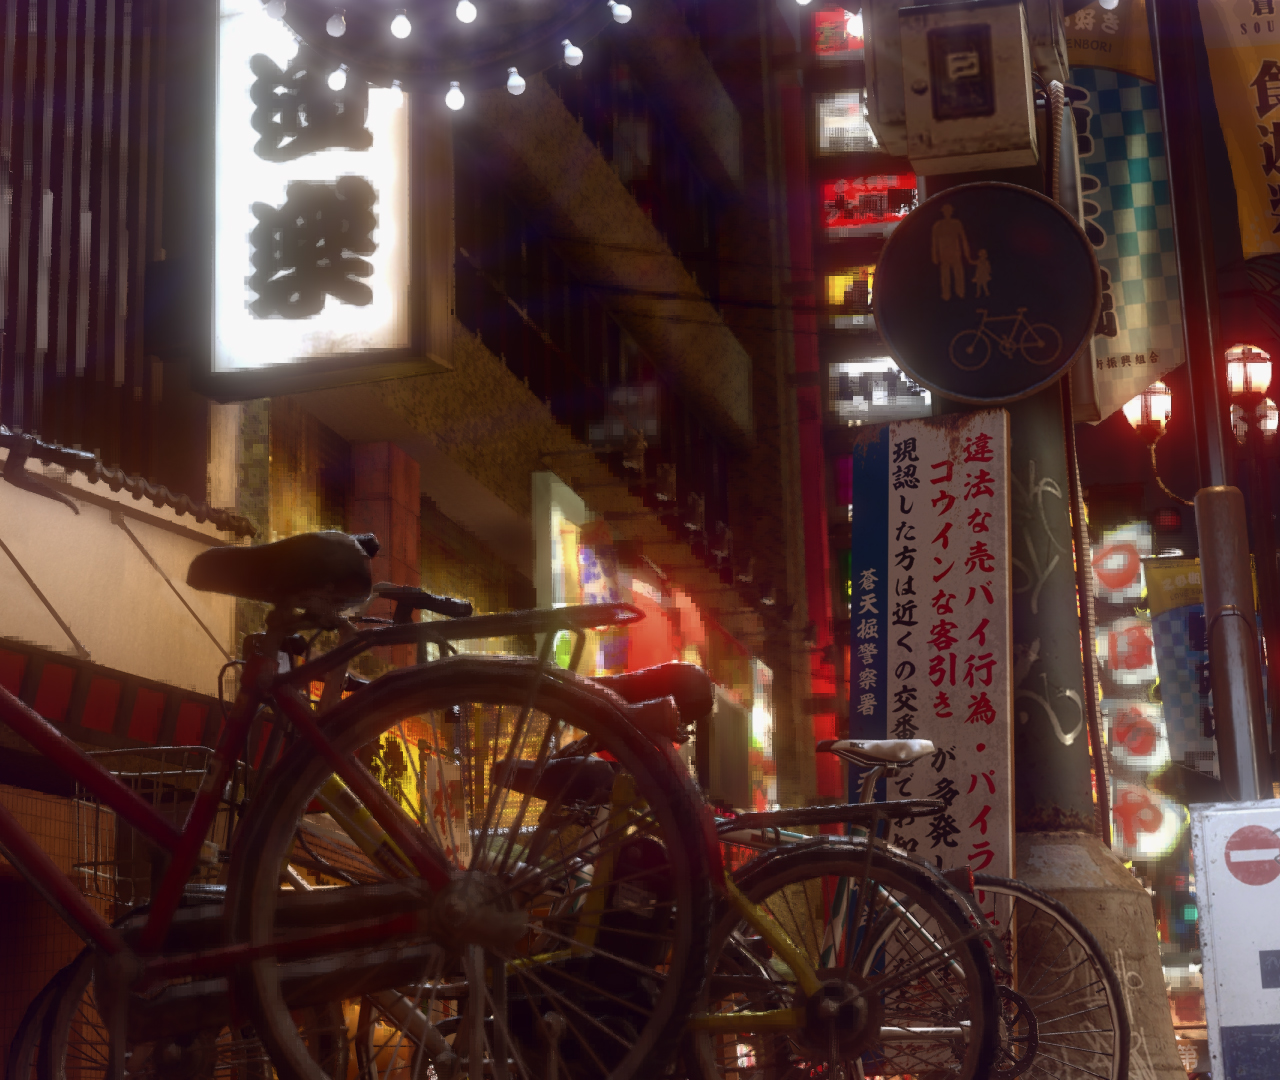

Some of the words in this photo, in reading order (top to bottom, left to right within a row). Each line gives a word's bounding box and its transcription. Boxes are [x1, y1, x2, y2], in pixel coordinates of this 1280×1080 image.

[856, 567, 880, 716] 蒼天堀警察署
